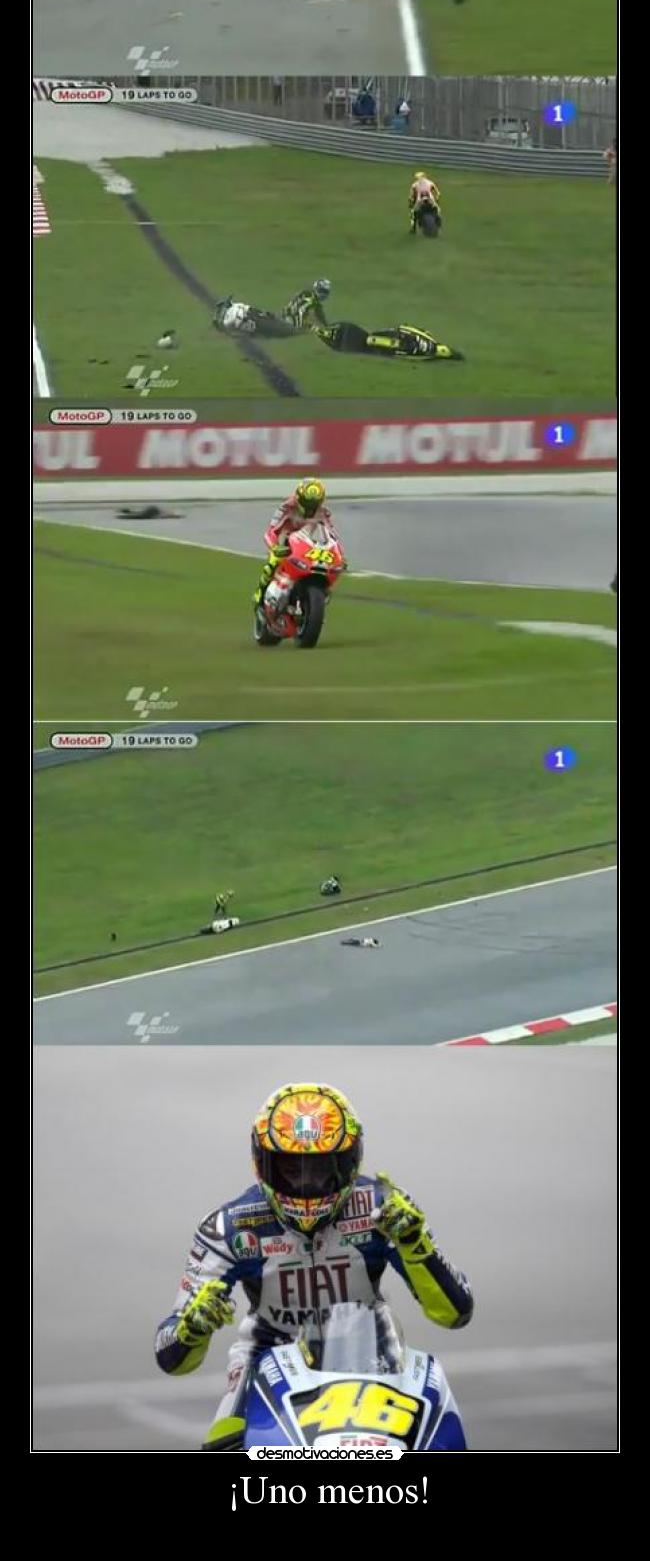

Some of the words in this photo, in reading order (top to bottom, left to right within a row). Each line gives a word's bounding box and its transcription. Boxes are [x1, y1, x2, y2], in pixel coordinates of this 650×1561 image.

[136, 426, 320, 469] MOTUL
[355, 420, 542, 465] MOTUL
[278, 1263, 350, 1309] FIAT
[297, 1381, 419, 1436] 46
